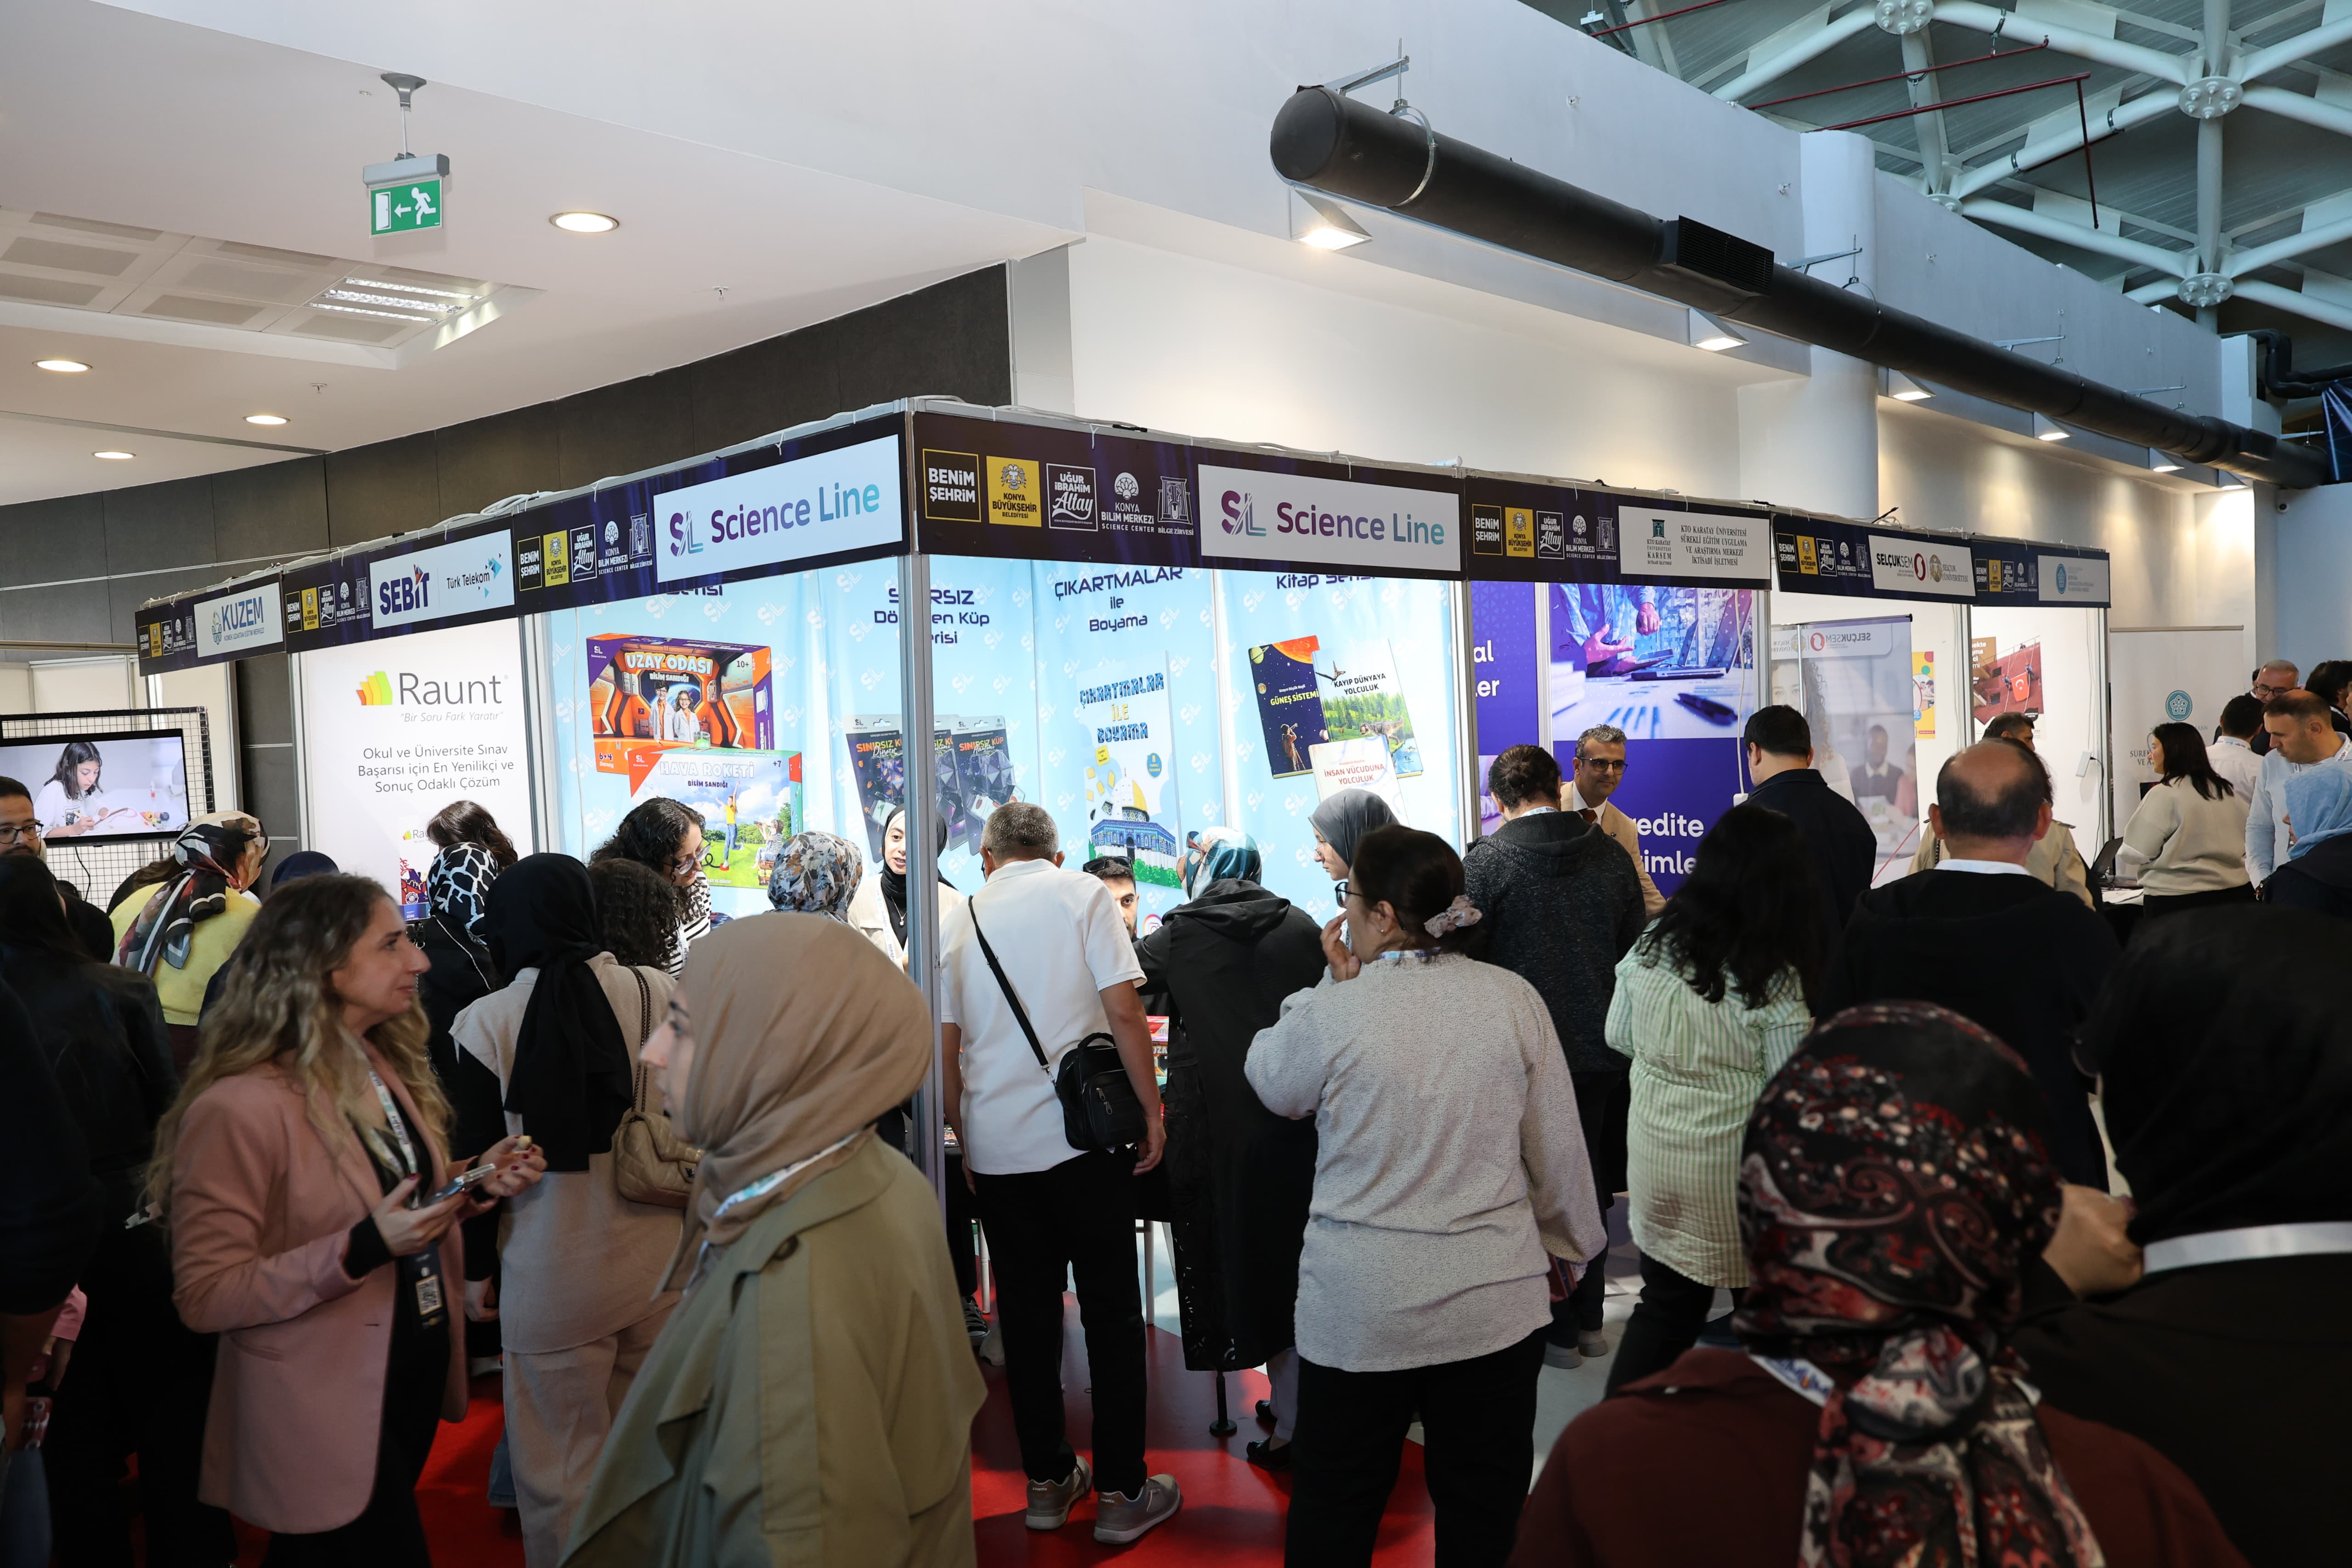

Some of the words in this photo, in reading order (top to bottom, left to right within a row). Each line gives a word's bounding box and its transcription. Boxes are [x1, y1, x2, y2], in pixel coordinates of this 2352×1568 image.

[928, 467, 975, 487] BENİM
[1060, 471, 1084, 484] UĞUR
[1054, 481, 1091, 493] İBRAHİM
[929, 487, 976, 503] ŞEHRİM
[1003, 492, 1026, 501] KONYA
[711, 498, 810, 543] Science
[819, 482, 879, 522] Line
[992, 499, 1037, 513] BÜYÜKŞEHİR
[1052, 491, 1093, 520] Altay
[1115, 502, 1140, 513] KONYA
[1101, 511, 1122, 522] BİLİM
[1123, 513, 1154, 525] MERKEZİ
[1277, 502, 1385, 540] Science
[1393, 513, 1444, 545] Line
[1475, 517, 1499, 530] BENİM
[1544, 516, 1557, 525] UĞUR
[1102, 523, 1129, 531] SCIENCE
[1174, 527, 1194, 536] ZİRVESİ
[1693, 526, 1714, 535] KARATAY
[1716, 526, 1747, 537] ÜNİVERSİTESİ
[577, 532, 589, 542] UĞUR
[1476, 531, 1500, 542] ŞEHRİM
[1508, 539, 1532, 547] BÜYÜKŞEHİR
[1539, 531, 1562, 551] Altay
[1680, 535, 1701, 543] SÜREKLİ
[1703, 535, 1720, 545] EĞİTİM
[1722, 538, 1747, 547] UYGULAMA
[605, 547, 619, 556] KONYA
[1694, 546, 1721, 556] ARAŞTIRMA
[1723, 547, 1743, 556] MERKEZİ
[1779, 543, 1794, 553] BENİM
[520, 550, 539, 565] BENİM
[574, 549, 594, 573] Altay
[598, 559, 609, 568] BİLİM
[610, 555, 628, 566] MERKEZİ
[1647, 551, 1672, 560] KARSEM
[1692, 556, 1713, 565] İKTİSADİ
[1714, 557, 1738, 566] İŞLETMESİ
[1876, 553, 1913, 568] SELÇUKSEM
[520, 564, 540, 578] ŞEHRİM
[1943, 564, 1956, 572] SELÇUK
[447, 577, 460, 589] Türk
[462, 572, 490, 586] Telekom
[1055, 566, 1182, 601] ÇIKARTMALAR
[1277, 574, 1319, 589] Kitap
[888, 588, 975, 605] SRSIZ
[1110, 596, 1124, 609] ile
[221, 596, 264, 631] KUZEM
[874, 610, 953, 624] Döen
[959, 612, 989, 627] Küp
[1090, 615, 1148, 632] Boyama
[625, 652, 664, 670] UZAY
[667, 654, 712, 675] ODASI
[649, 672, 665, 682] BİLİM
[666, 673, 689, 683] SANDIĞI
[1334, 678, 1352, 688] KAYIP
[1355, 673, 1386, 684] DÜNYAYA
[399, 672, 503, 706] Raunt
[1080, 673, 1164, 709] ÇIKARTMALAR
[1344, 684, 1379, 695] YOLCULUK
[1270, 696, 1292, 706] GÜNEŞ
[1292, 688, 1319, 702] SİSTEMİ
[420, 713, 442, 722] Soru
[446, 712, 465, 721] Fark
[1112, 703, 1129, 721] İLE
[1097, 722, 1148, 743] BOYAMA
[991, 736, 1004, 745] KÜP
[363, 747, 392, 760] Okul
[396, 749, 411, 758] ve
[415, 744, 474, 758] Üniversite
[478, 744, 508, 756] Sınav
[599, 753, 612, 761] 6+4
[358, 764, 405, 778] Başarısı
[409, 763, 429, 776] için
[434, 763, 447, 773] En
[451, 761, 498, 774] Yenilikçi
[501, 760, 514, 770] ve
[660, 761, 698, 776] HAVA
[703, 761, 754, 778] ROKETİ
[1346, 764, 1385, 775] VÜCUDUNA
[375, 781, 414, 793] Sonuç
[418, 778, 456, 791] Odaklı
[459, 777, 500, 790] Çözüm
[1339, 775, 1374, 785] YOLCULUK
